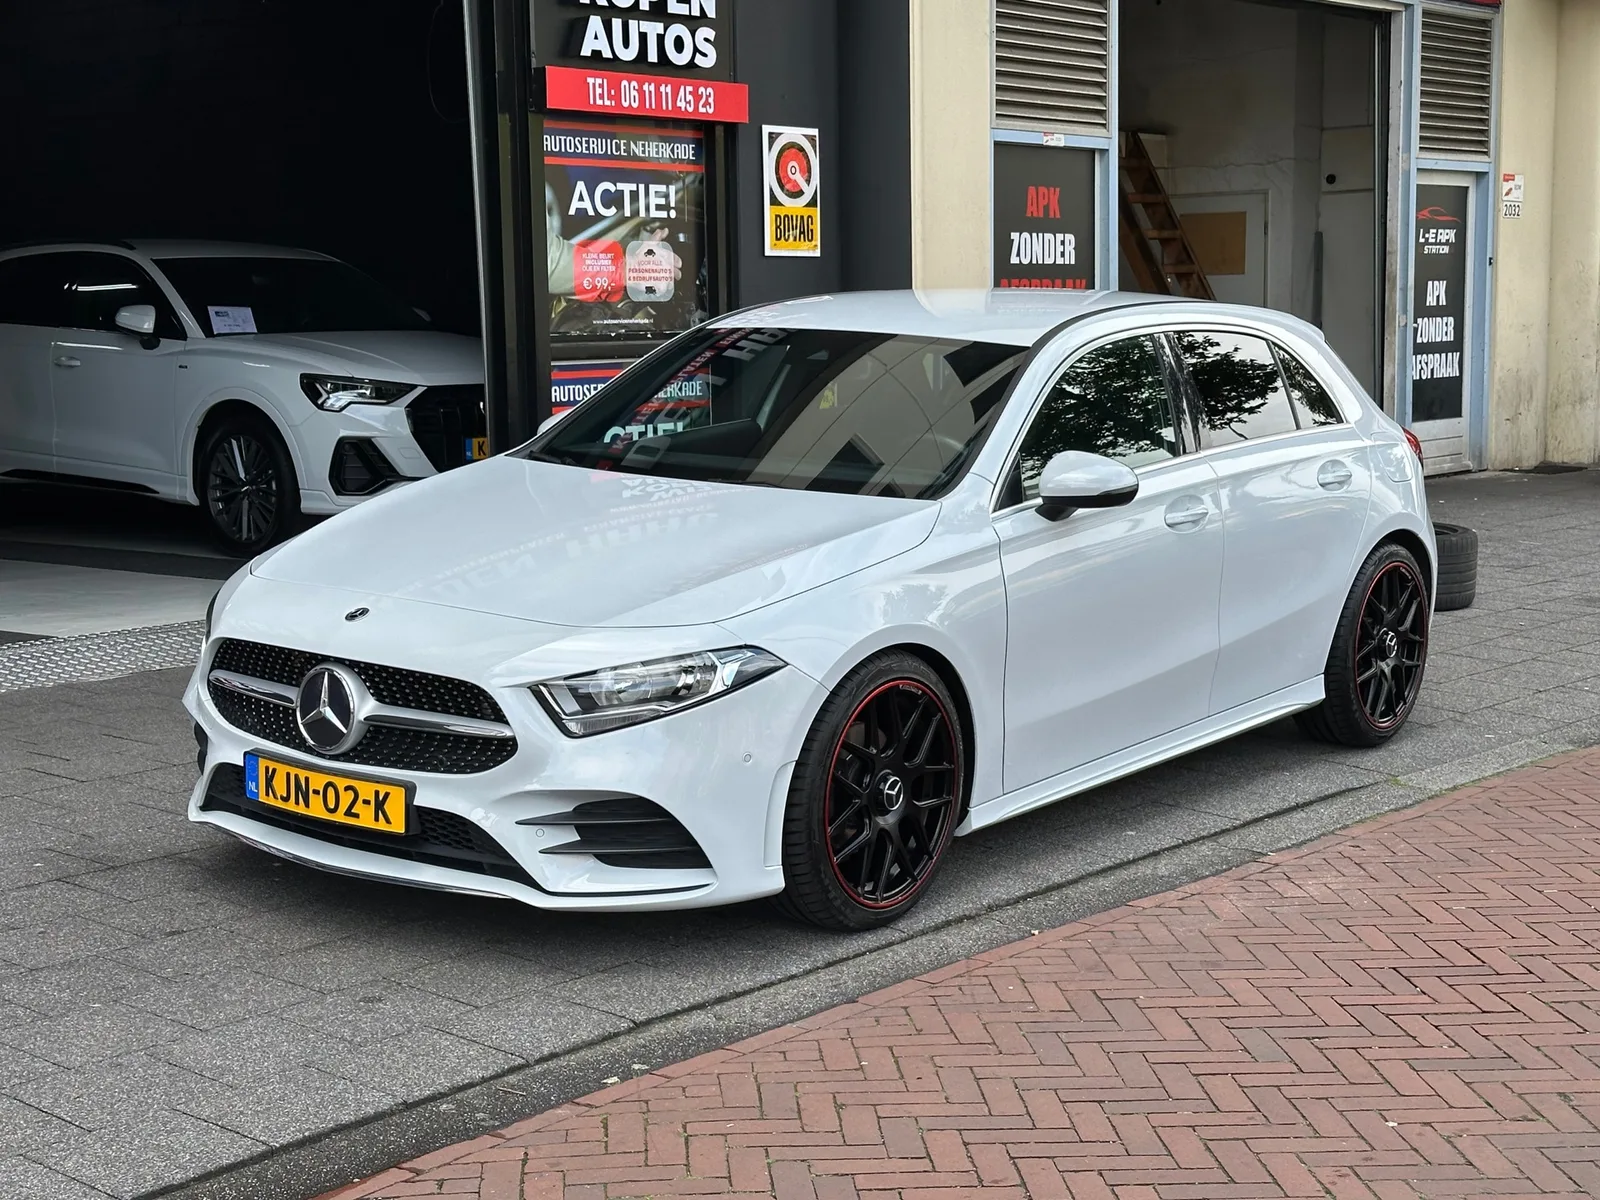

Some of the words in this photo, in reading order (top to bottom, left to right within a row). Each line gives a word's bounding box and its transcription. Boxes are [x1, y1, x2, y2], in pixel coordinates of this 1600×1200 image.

[580, 15, 717, 68] AUTOS
[587, 77, 615, 107] TEL:
[620, 79, 639, 107] 06
[643, 82, 656, 110] 11
[660, 84, 672, 111] 11
[677, 85, 693, 112] 45
[698, 86, 714, 114] 23
[543, 134, 628, 157] AUTOSERVICE
[630, 140, 696, 160] NEHERKADE
[568, 180, 677, 219] ACTIE!
[1025, 186, 1061, 219] APK
[1503, 203, 1521, 217] 2032
[774, 213, 814, 243] BOVAG
[1437, 228, 1456, 243] APK
[1010, 232, 1076, 265] ZONDER
[1423, 245, 1450, 254] STATION
[1426, 280, 1447, 307] APK
[1416, 316, 1454, 343] ZONDER
[248, 781, 258, 793] NL
[264, 765, 392, 825] KJN-02-K
